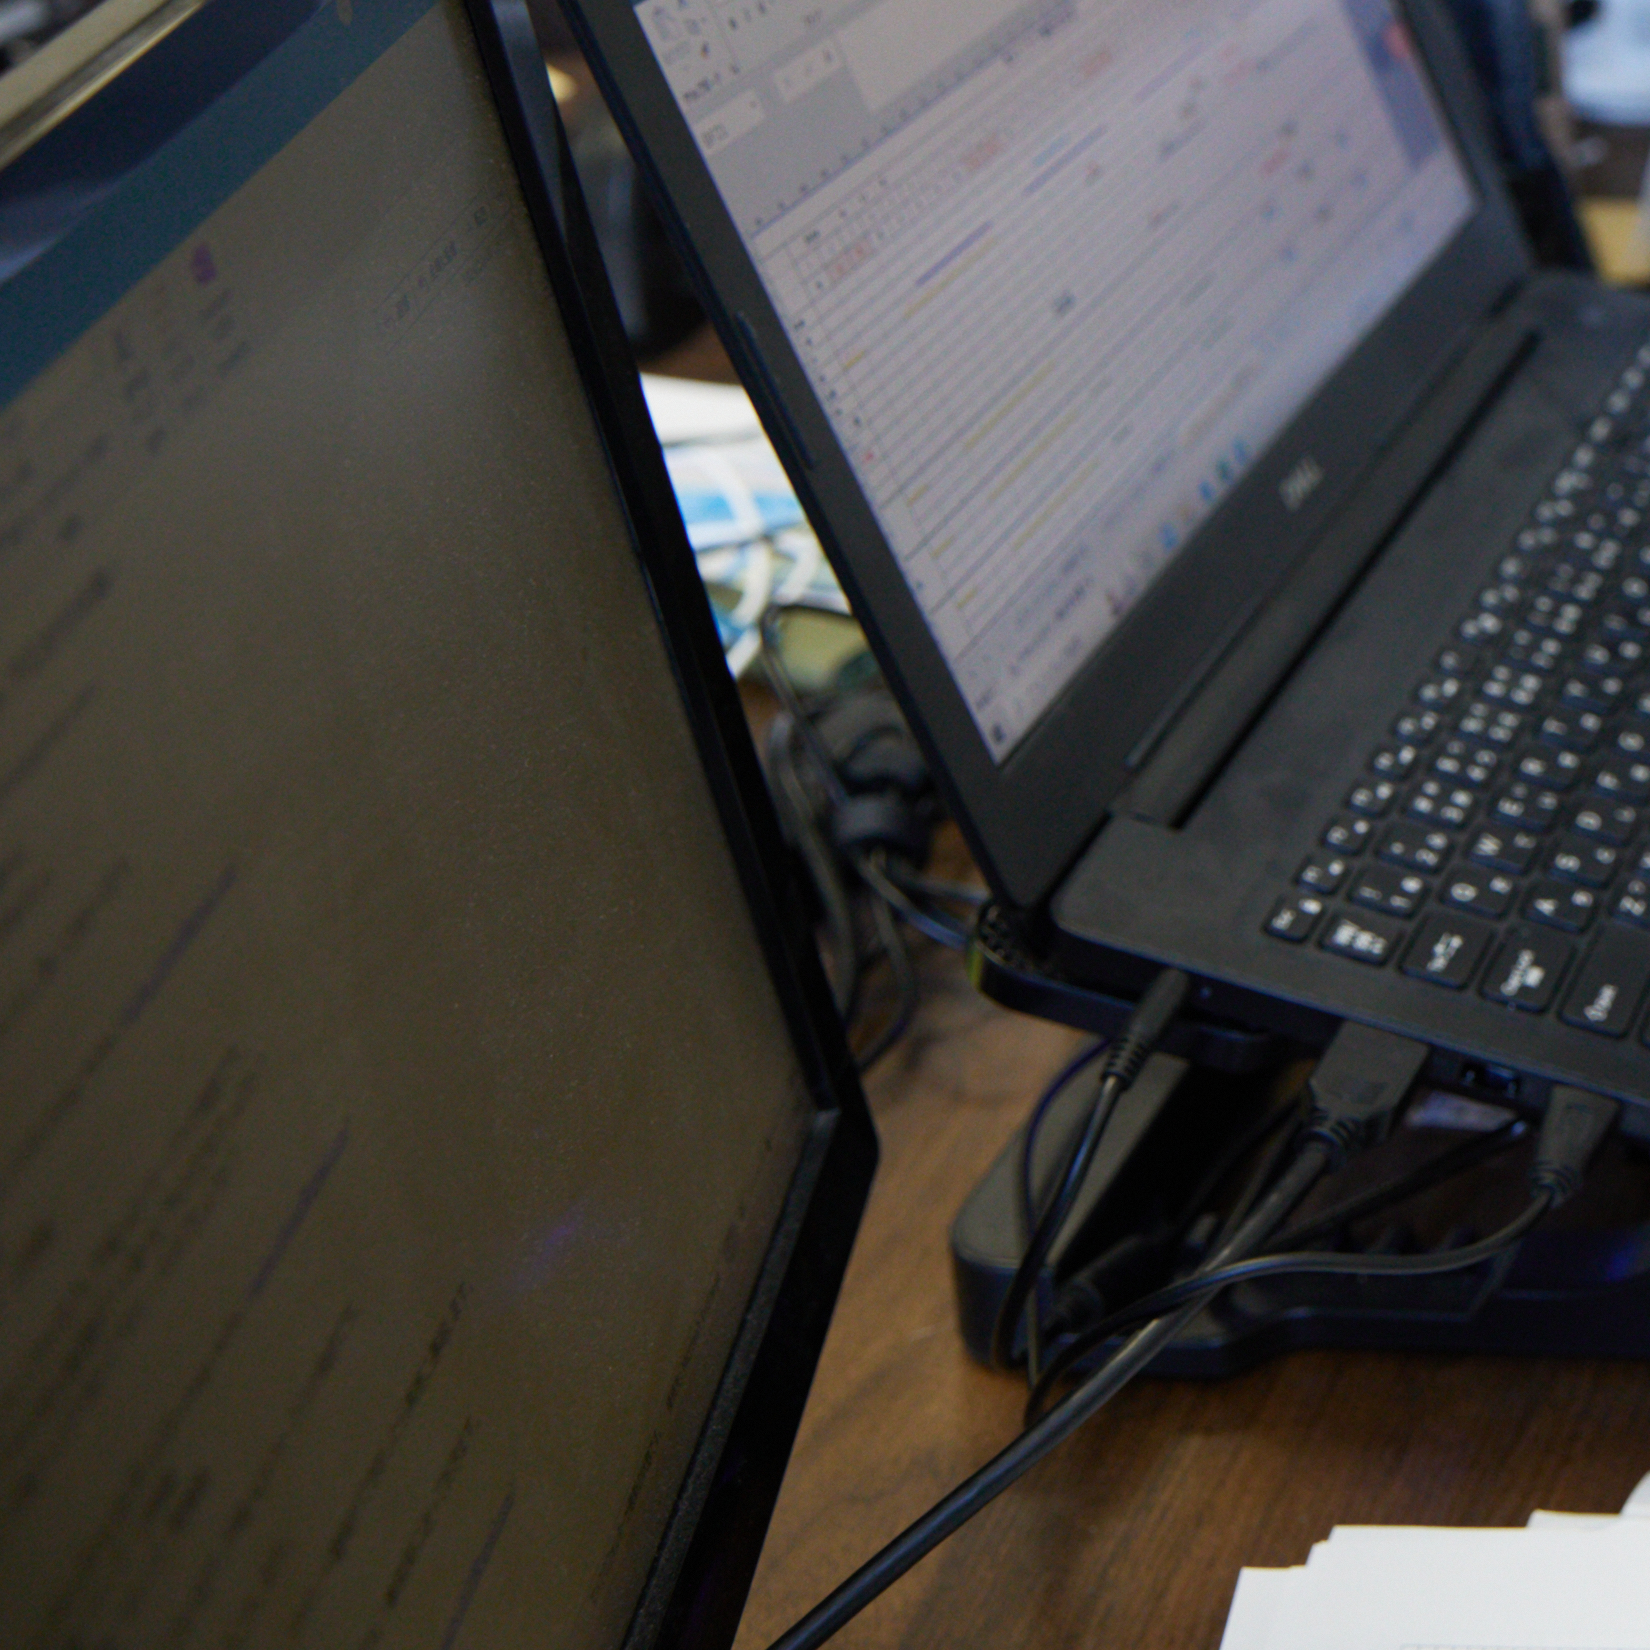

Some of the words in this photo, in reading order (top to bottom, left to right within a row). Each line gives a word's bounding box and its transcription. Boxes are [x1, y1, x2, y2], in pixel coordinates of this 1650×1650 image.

[1476, 834, 1500, 856] W
[1554, 854, 1580, 871] S
[1534, 898, 1556, 915] A
[1619, 895, 1646, 916] Z
